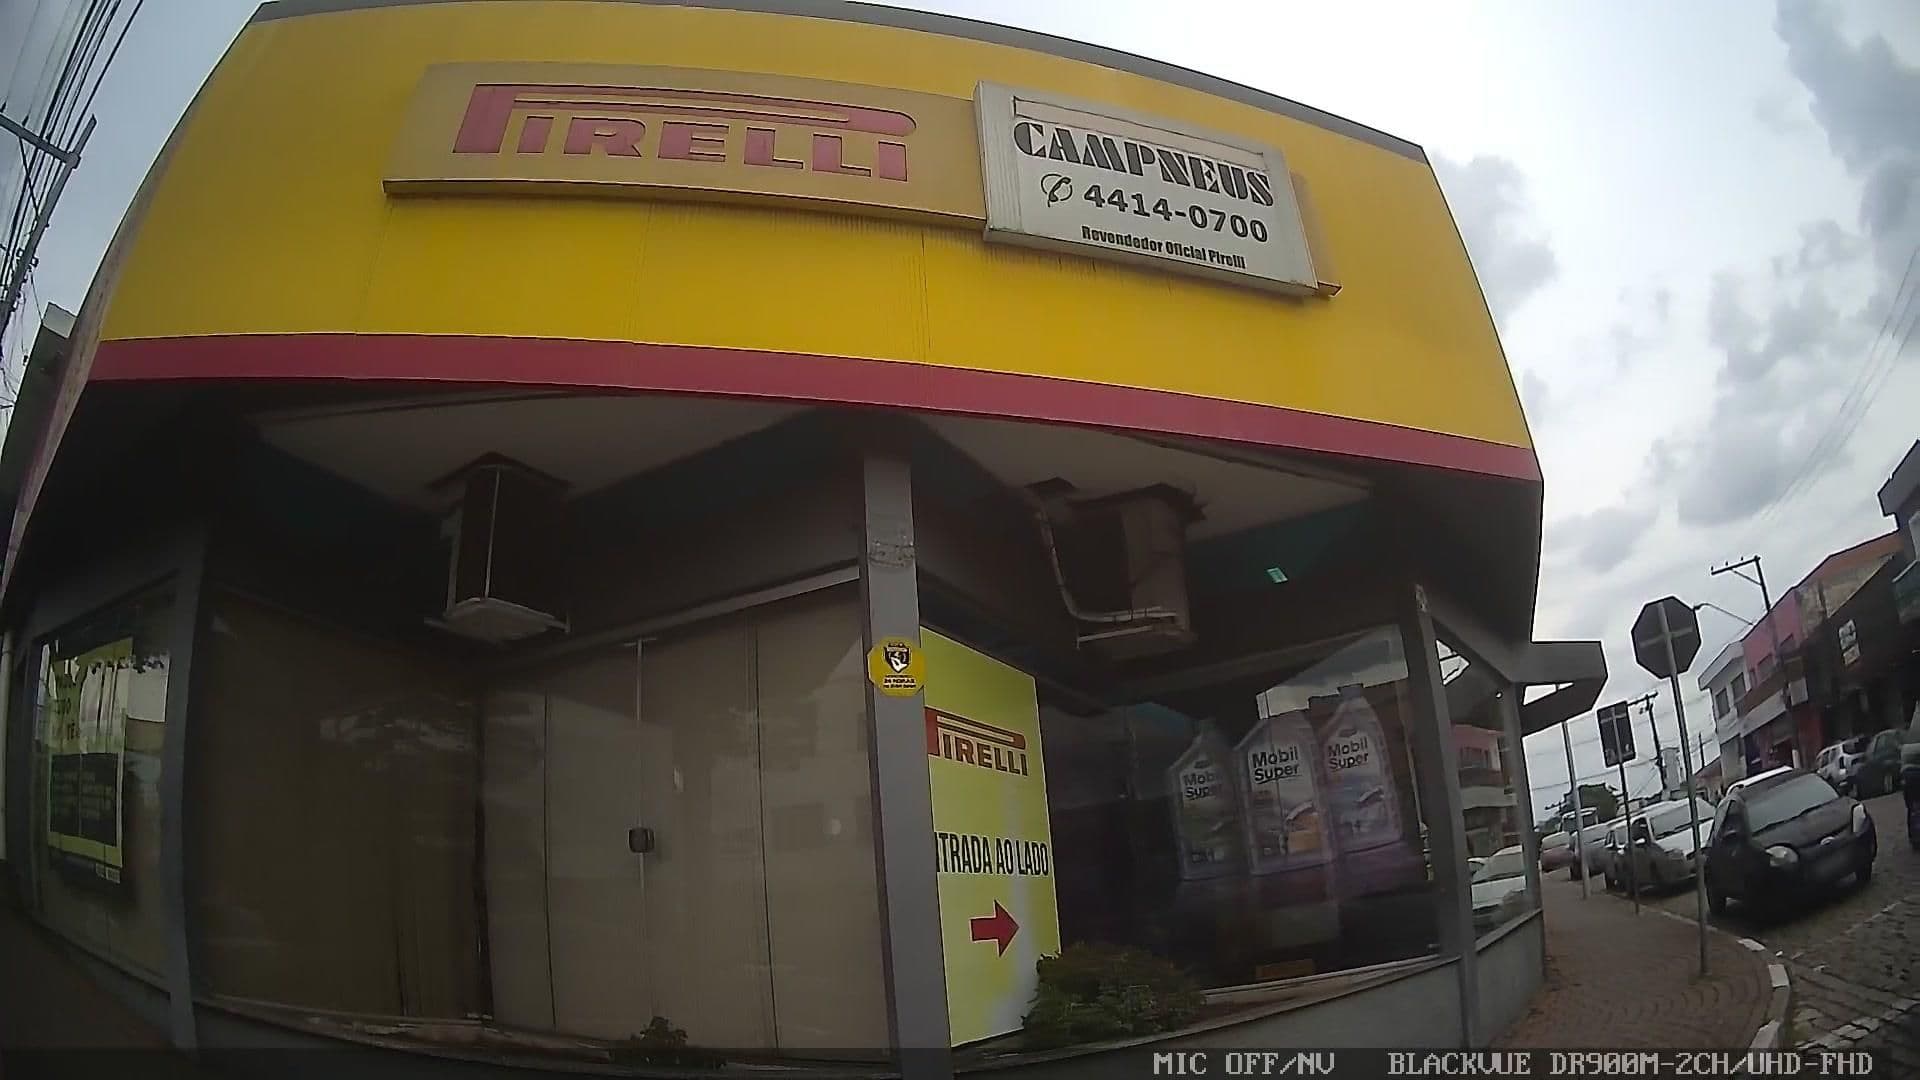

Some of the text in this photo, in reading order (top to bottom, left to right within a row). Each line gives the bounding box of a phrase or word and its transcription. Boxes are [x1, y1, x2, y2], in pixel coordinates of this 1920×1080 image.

[452, 83, 916, 182] PIRELLI
[1013, 121, 1274, 207] CAMPNEUS
[1083, 184, 1269, 243] 4414-0700
[1081, 225, 1247, 269] Revendedor Oficial Pirelli
[925, 706, 1028, 776] PIRELLI
[1252, 745, 1299, 769] Mobil
[1328, 736, 1369, 757] Mobil
[1329, 752, 1369, 770] Super
[1254, 763, 1300, 782] Super
[995, 837, 1014, 875] AO
[1015, 839, 1049, 876] LADO
